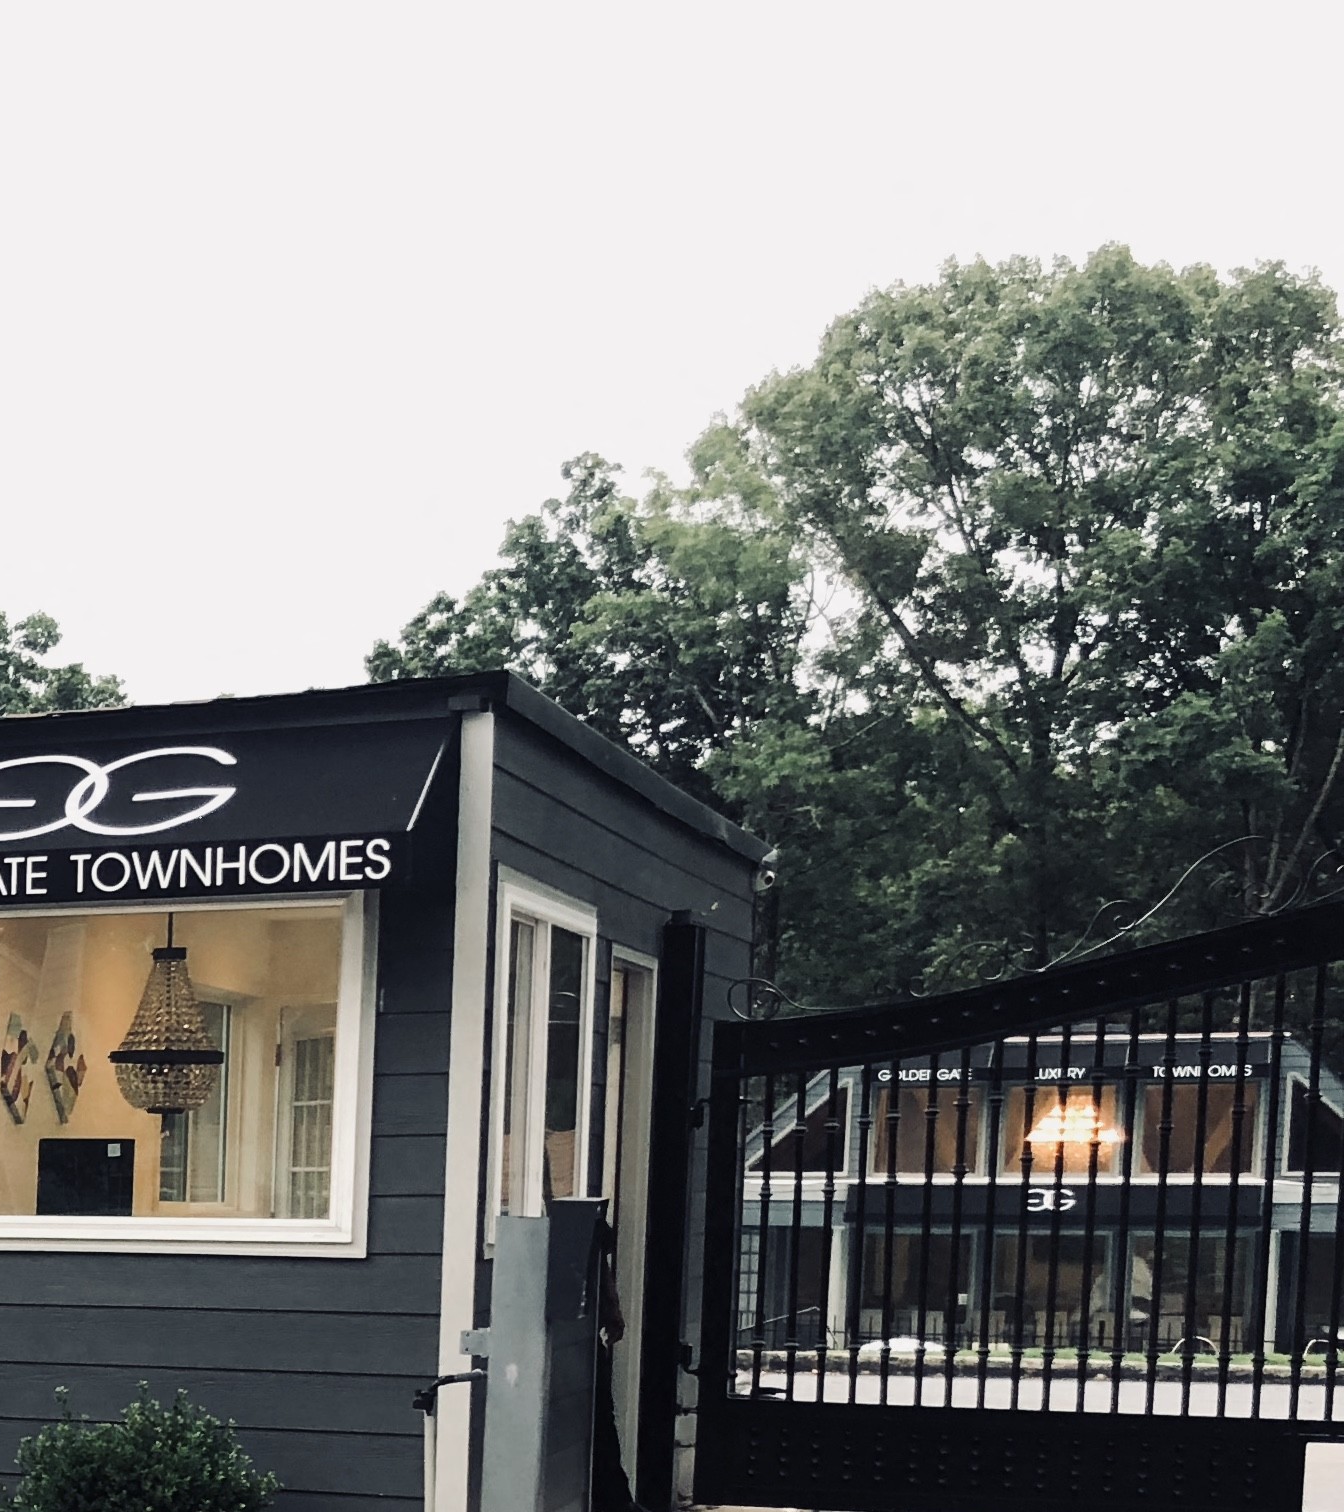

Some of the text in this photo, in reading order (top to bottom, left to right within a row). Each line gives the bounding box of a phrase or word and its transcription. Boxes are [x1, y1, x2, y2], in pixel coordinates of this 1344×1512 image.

[69, 838, 392, 894] TOWNHOMES
[877, 1068, 973, 1082] GLDEGA
[1152, 1064, 1254, 1078] TWNOMS
